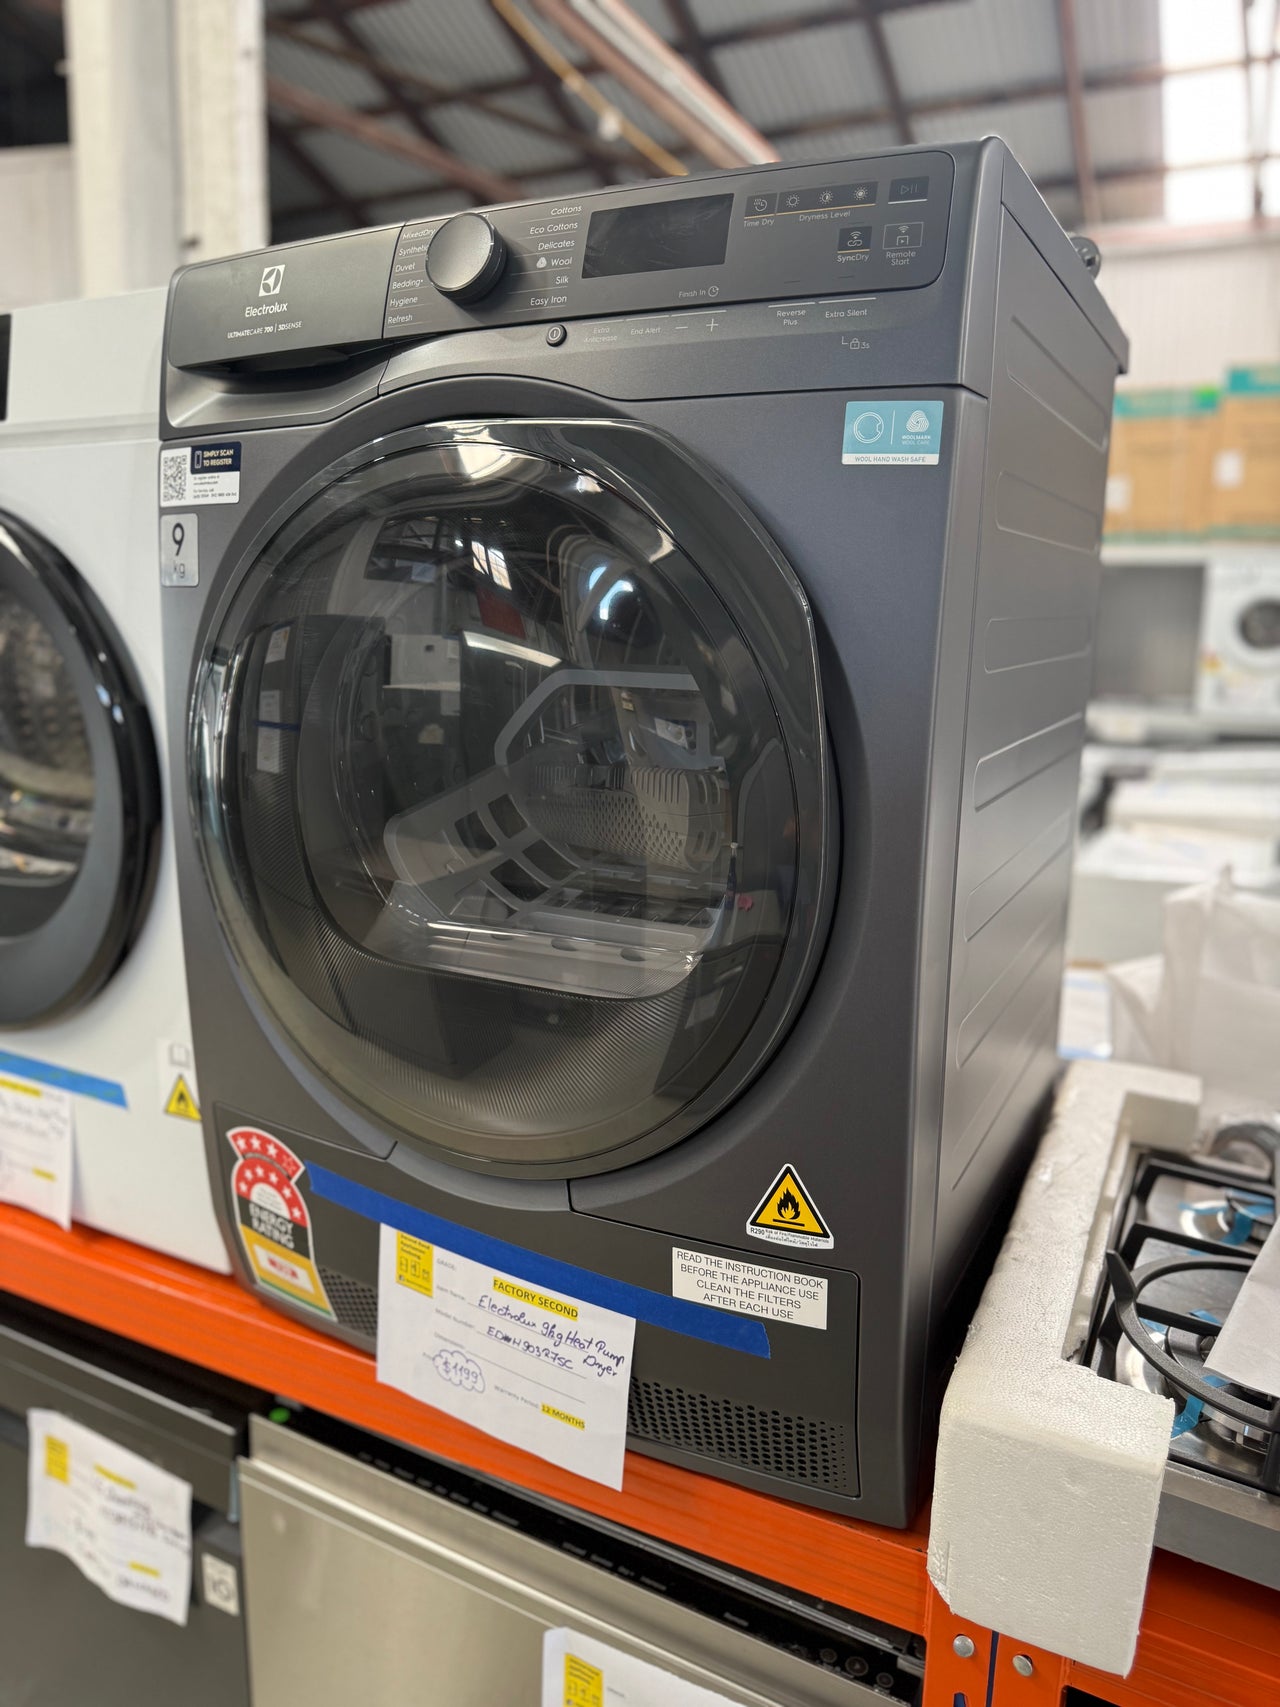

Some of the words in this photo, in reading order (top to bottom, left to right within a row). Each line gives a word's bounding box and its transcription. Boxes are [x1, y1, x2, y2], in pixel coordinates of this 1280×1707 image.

[550, 205, 582, 216] Cottons
[799, 212, 829, 223] Dryness
[830, 210, 851, 219] Level
[529, 225, 545, 235] Eco
[546, 222, 579, 233] Cottons
[743, 219, 760, 228] Time
[761, 218, 775, 227] Dry
[402, 229, 436, 240] MixedDry
[537, 240, 576, 251] Delicates
[836, 253, 870, 264] SyncDry
[885, 250, 916, 259] Remote
[550, 256, 573, 267] Wool
[890, 258, 910, 266] Start
[395, 262, 416, 273] Duvet
[555, 275, 569, 285] Silk
[678, 290, 698, 299] Finish
[699, 289, 706, 297] In
[389, 296, 418, 308] Hygiene
[530, 297, 549, 307] Easy
[550, 295, 568, 304] Iron
[245, 301, 289, 318] Electrolux
[776, 309, 806, 318] Reverse
[825, 310, 845, 319] Extra
[847, 308, 868, 318] Silent
[387, 314, 413, 325] Refresh
[783, 318, 798, 326] Plus
[630, 328, 644, 336] End
[645, 326, 662, 335] Alert
[203, 450, 220, 458] SIMPLY
[220, 448, 234, 457] SCAN
[203, 459, 210, 467] TO
[210, 457, 233, 467] REGISTER
[855, 455, 872, 463] WOOL
[873, 455, 890, 463] HAND
[891, 455, 909, 463] WASH
[910, 455, 926, 463] SAFE
[172, 522, 185, 557] 9
[249, 1202, 294, 1235] ENERGY
[251, 1217, 295, 1250] RATING
[676, 1250, 702, 1264] READ
[704, 1256, 723, 1269] THE
[725, 1261, 791, 1283] INSTRUCTION
[793, 1276, 824, 1290] BOOK
[680, 1263, 718, 1280] BEFORE
[719, 1272, 739, 1285] THE
[741, 1278, 796, 1297] APPLIANCE
[798, 1289, 820, 1301] USE
[493, 1279, 537, 1303] FACTORY
[537, 1296, 578, 1318] SECOND
[696, 1279, 732, 1295] CLEAN
[733, 1287, 755, 1300] THE
[757, 1292, 802, 1310] FILTERS
[702, 1292, 737, 1308] AFTER
[739, 1301, 769, 1315] EACH
[771, 1307, 794, 1320] USE
[478, 1294, 537, 1328] Electrolux
[565, 1330, 594, 1350] Heat
[594, 1340, 625, 1367] Pump
[582, 1354, 618, 1378] Dryer
[541, 1403, 551, 1414] 12
[551, 1408, 586, 1429] MONTHS
